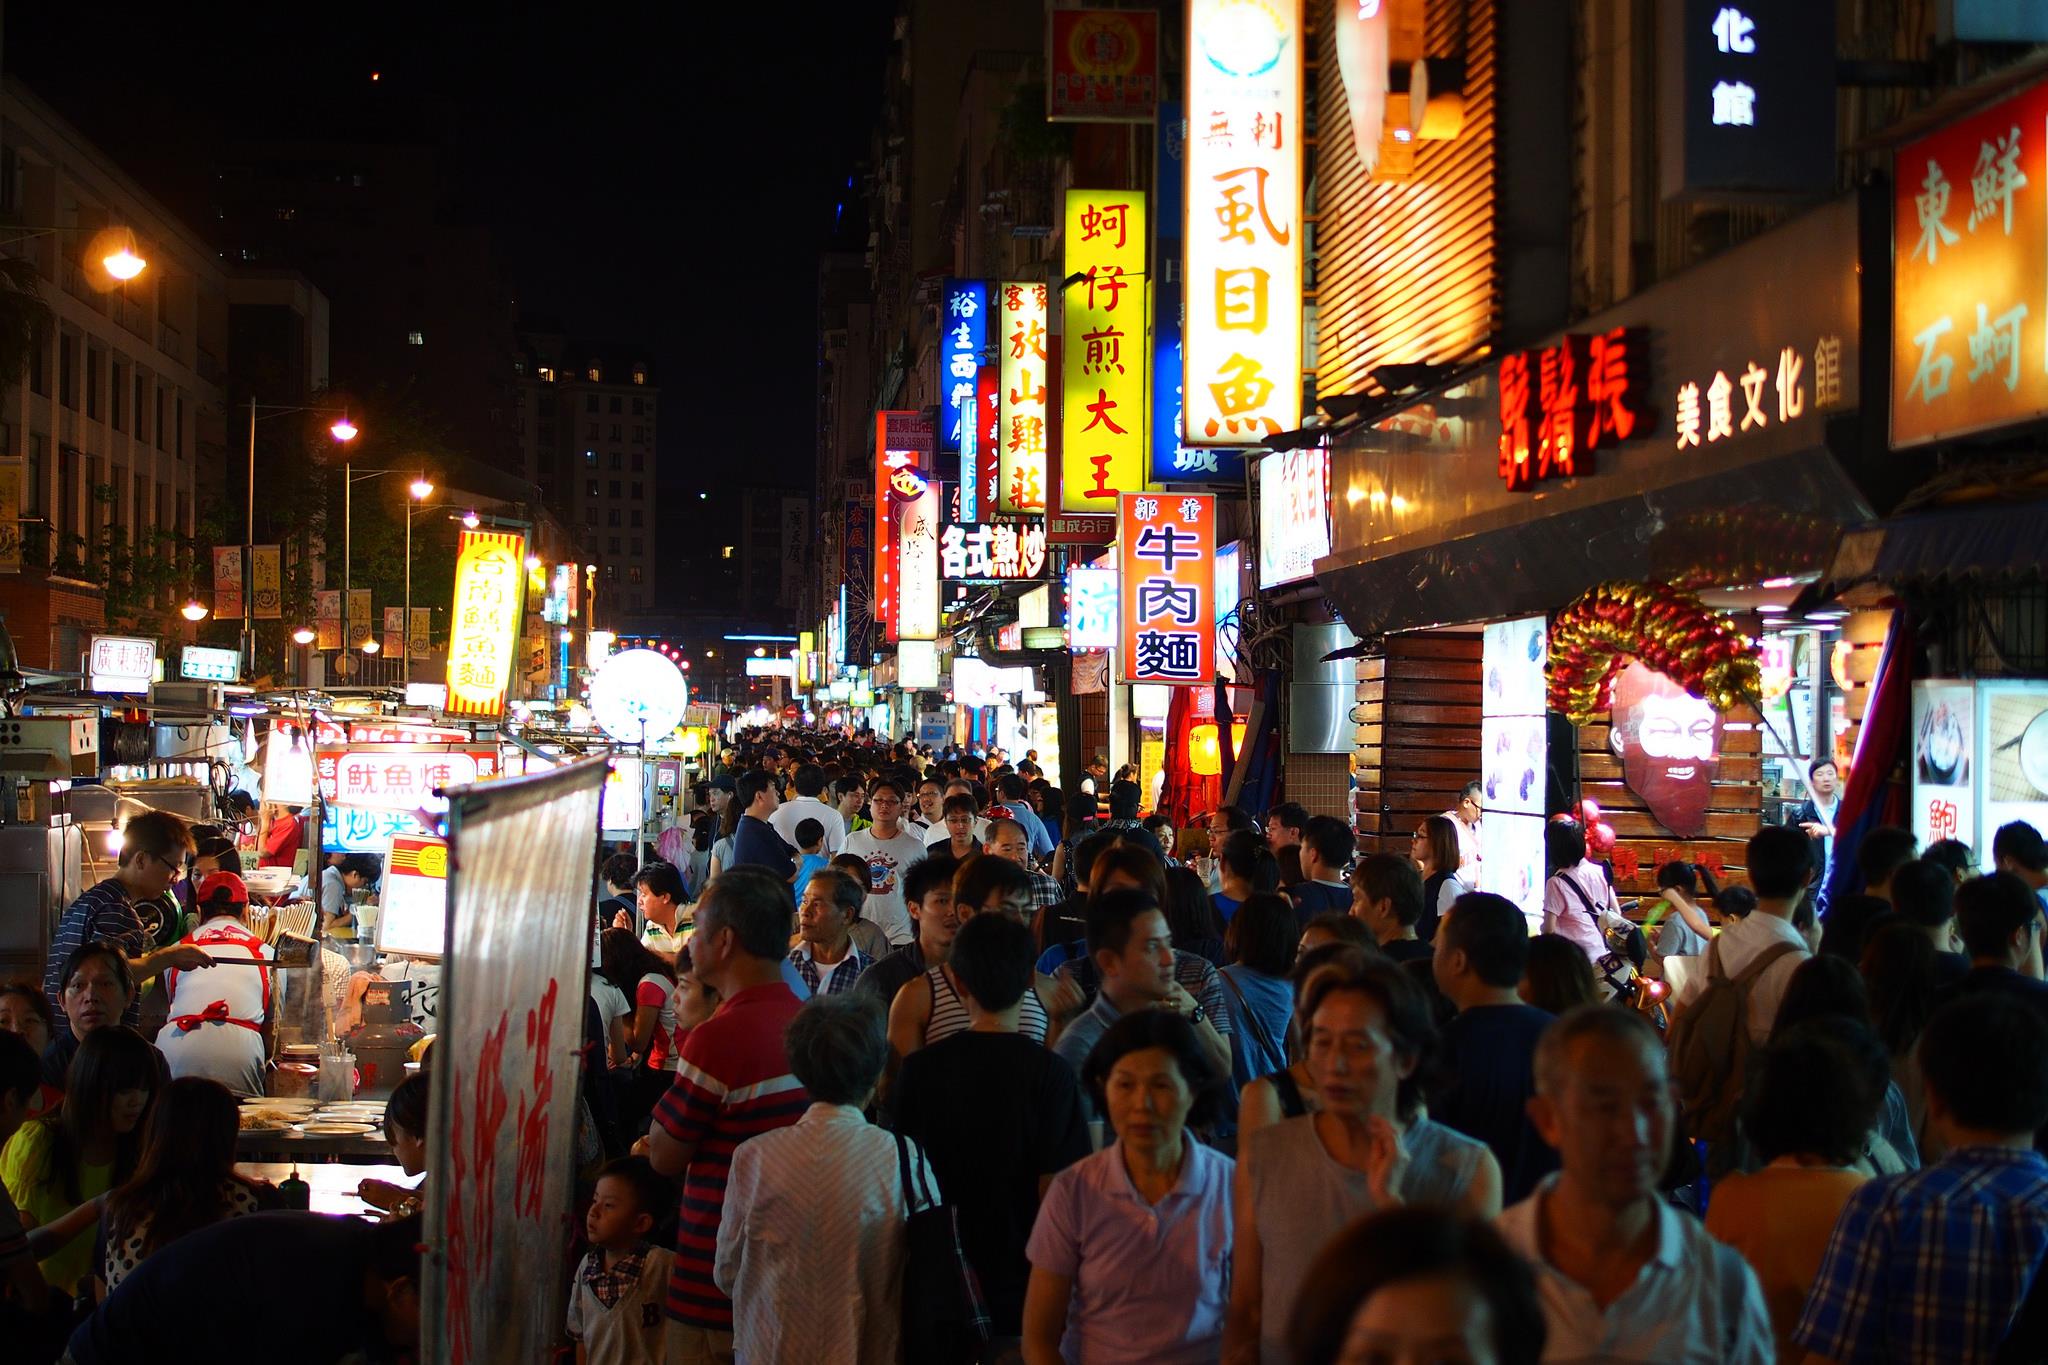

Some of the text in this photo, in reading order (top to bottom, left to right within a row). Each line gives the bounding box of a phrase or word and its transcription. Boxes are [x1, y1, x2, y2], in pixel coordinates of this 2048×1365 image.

[1205, 166, 1291, 440] 虱目魚
[1904, 159, 1961, 404] 東石
[1967, 126, 2028, 393] 鮮蚵
[1080, 203, 1130, 499] 蚵仔煎大王
[1676, 334, 1841, 451] 美食文化館
[939, 523, 1048, 578] 各式熱炒
[1051, 518, 1111, 534] 建成分行
[1136, 525, 1200, 678] 牛肉麵
[98, 642, 150, 674] 廣東粥
